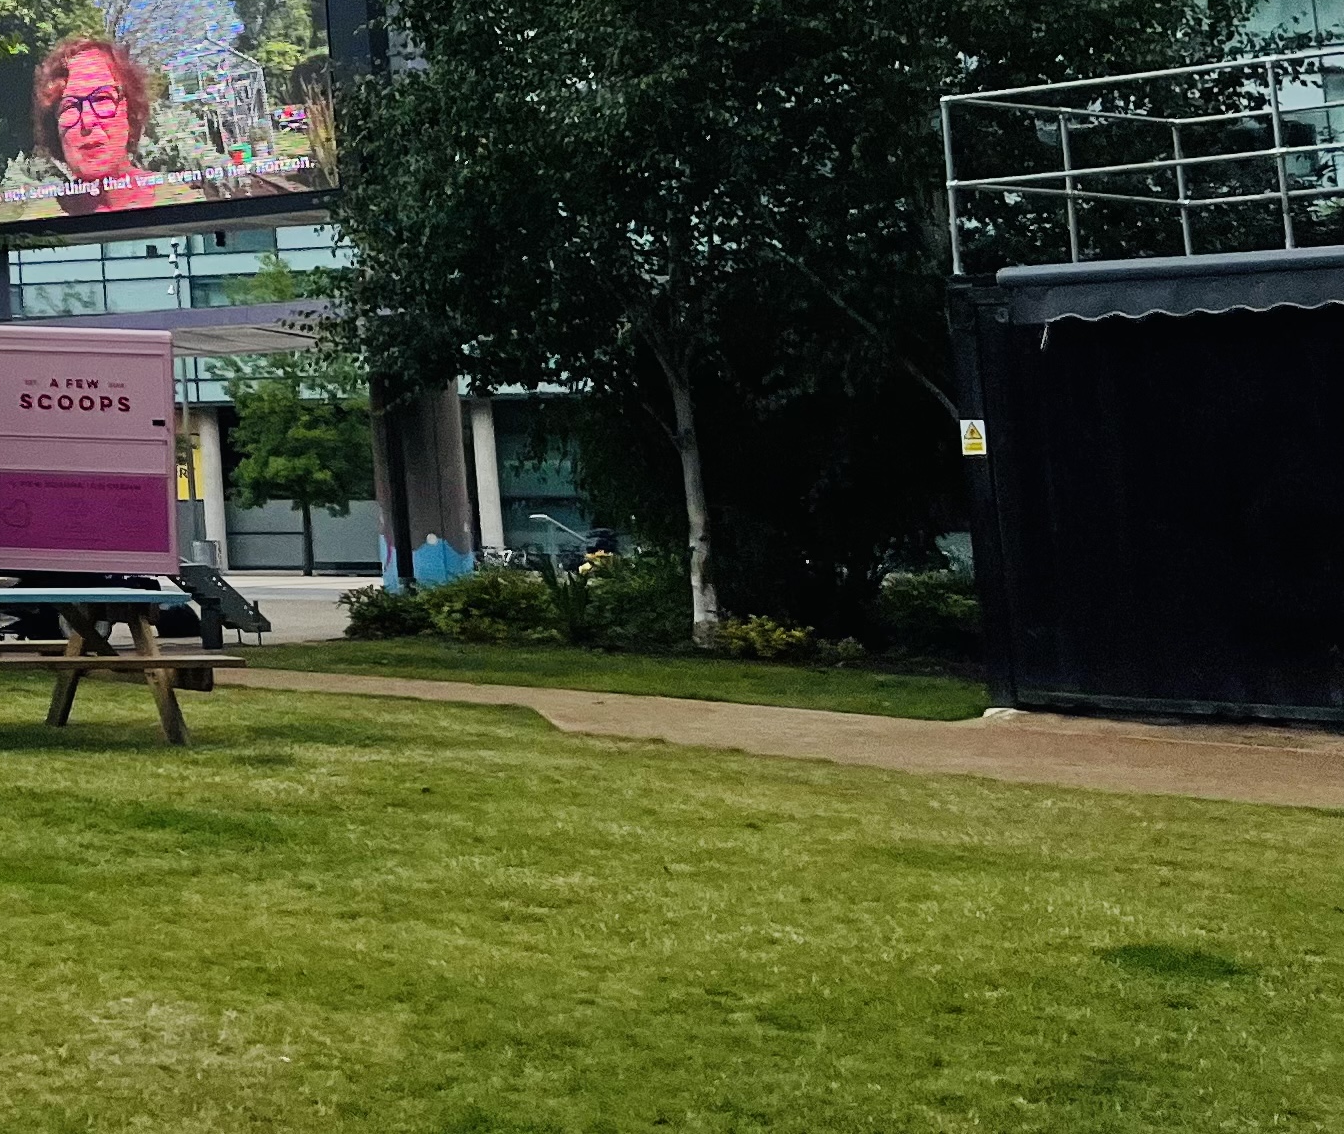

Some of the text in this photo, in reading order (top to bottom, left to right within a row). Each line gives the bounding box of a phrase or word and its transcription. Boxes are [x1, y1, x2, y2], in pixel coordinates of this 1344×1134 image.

[27, 178, 100, 199] something
[103, 173, 132, 190] that
[167, 170, 202, 183] even
[49, 377, 59, 388] A
[65, 378, 99, 389] FEW
[18, 392, 131, 412] SCOOPS
